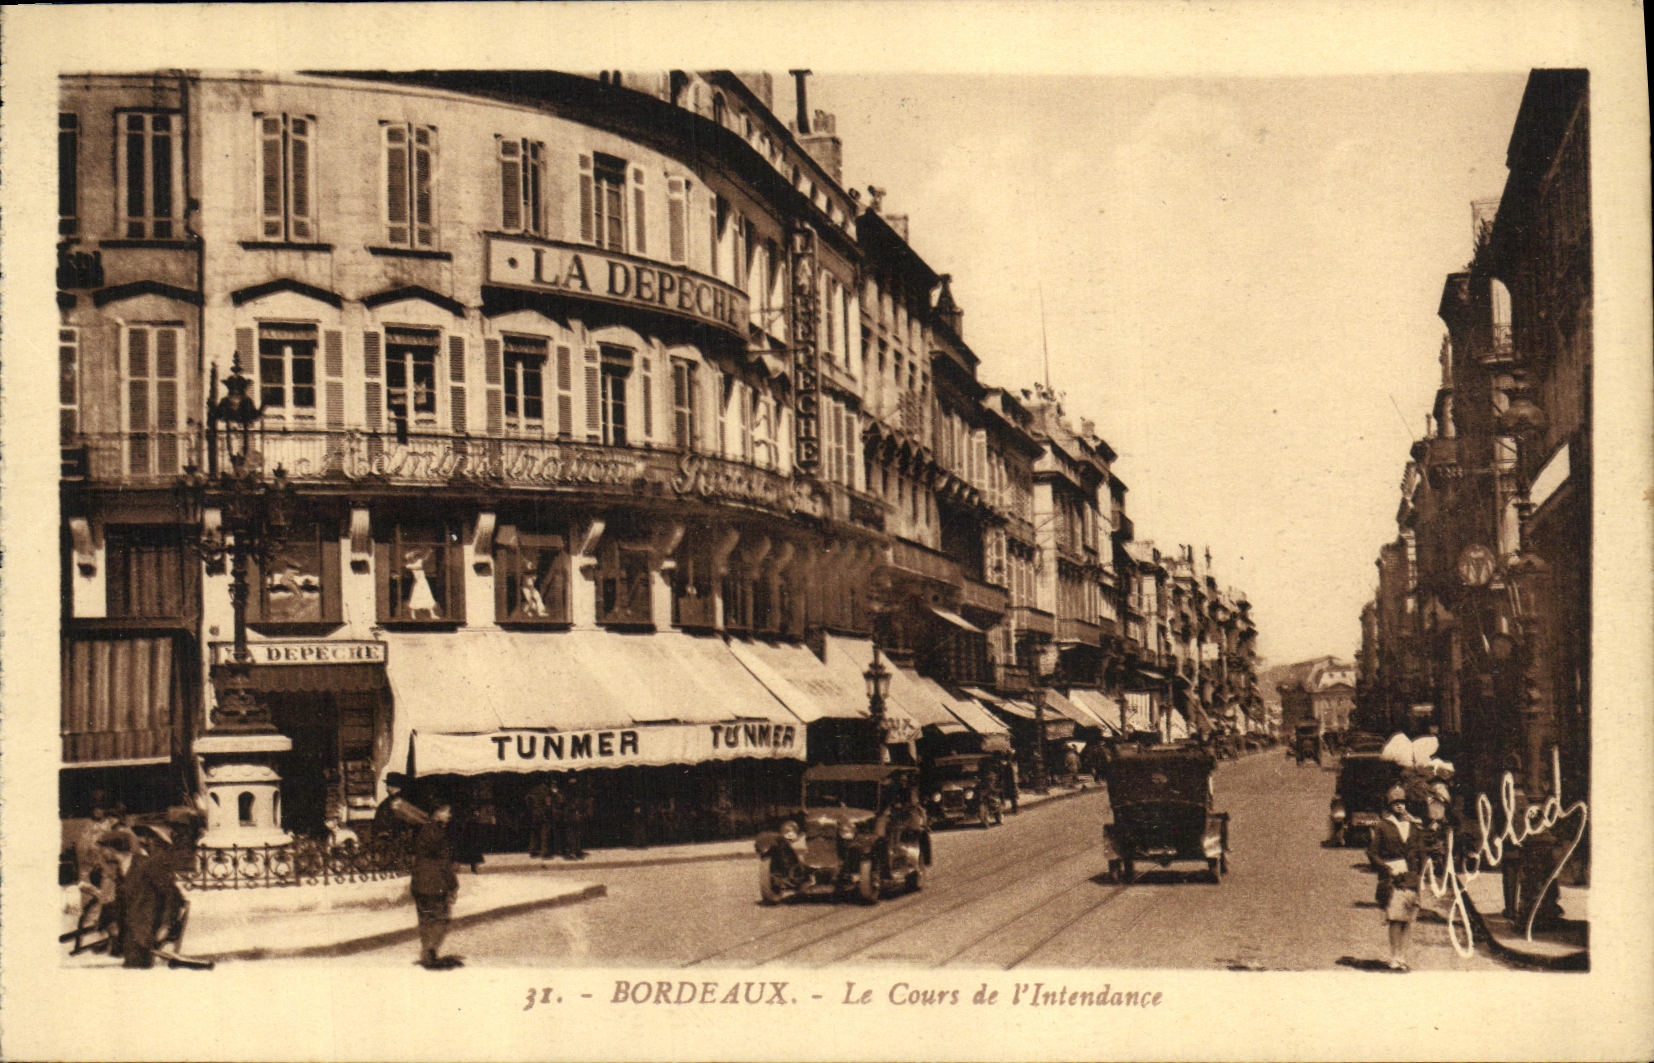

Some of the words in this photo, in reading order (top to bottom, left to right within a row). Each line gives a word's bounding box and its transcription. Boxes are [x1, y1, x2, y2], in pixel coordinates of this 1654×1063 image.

[530, 247, 592, 292] LA
[607, 259, 741, 326] DEPECHE
[265, 645, 380, 662] DEPECHE
[491, 730, 639, 761] TUNMER
[709, 722, 796, 751] TUNMER
